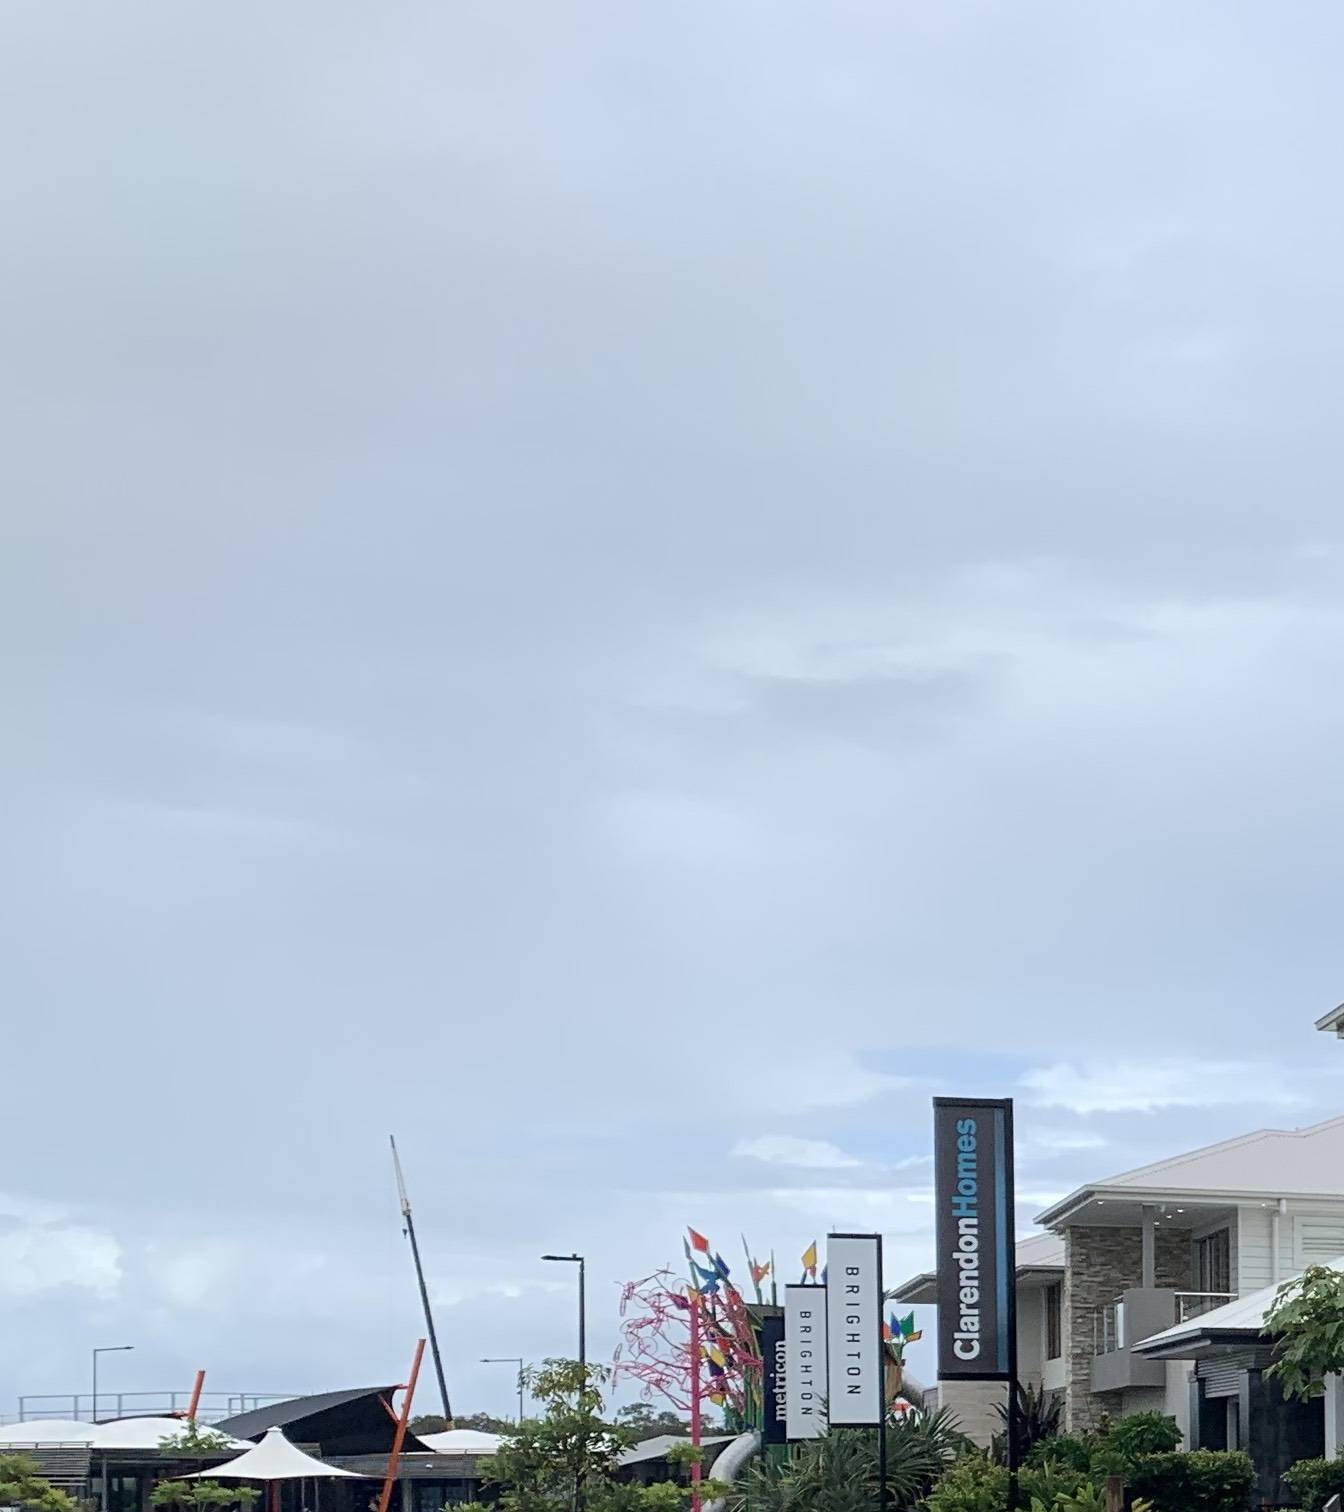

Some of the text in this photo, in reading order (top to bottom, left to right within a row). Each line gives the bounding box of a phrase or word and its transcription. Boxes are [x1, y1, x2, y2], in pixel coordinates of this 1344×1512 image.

[951, 1118, 980, 1361] ClarendonHomes
[770, 1340, 787, 1422] metricon
[799, 1311, 813, 1415] BRIGHTON
[845, 1266, 861, 1394] BRIGHTON
